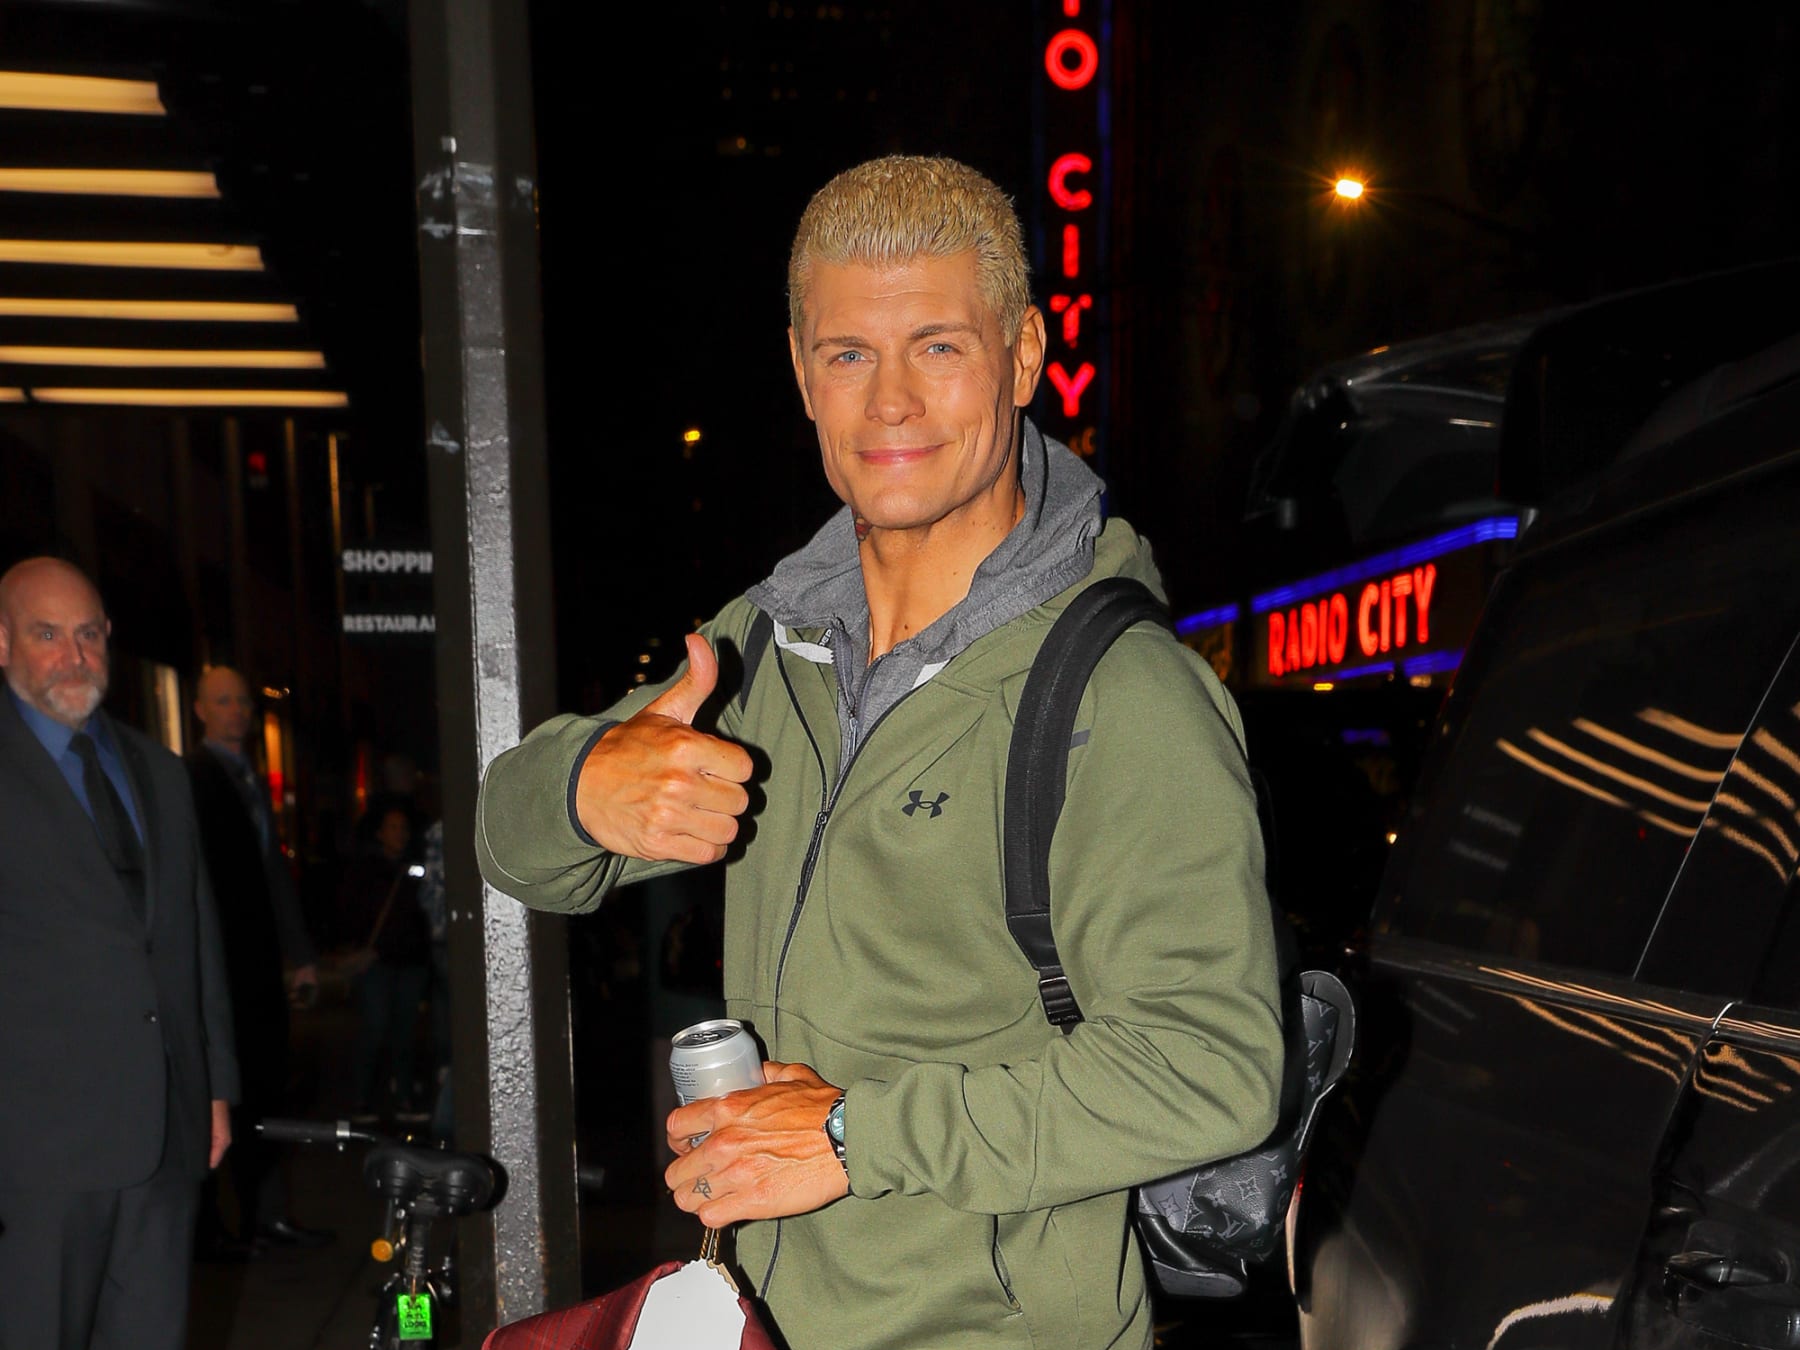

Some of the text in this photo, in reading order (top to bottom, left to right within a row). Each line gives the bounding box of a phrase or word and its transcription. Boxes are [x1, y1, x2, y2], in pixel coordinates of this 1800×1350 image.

[1046, 153, 1096, 417] CITY
[1268, 563, 1436, 677] RADIO CITY
